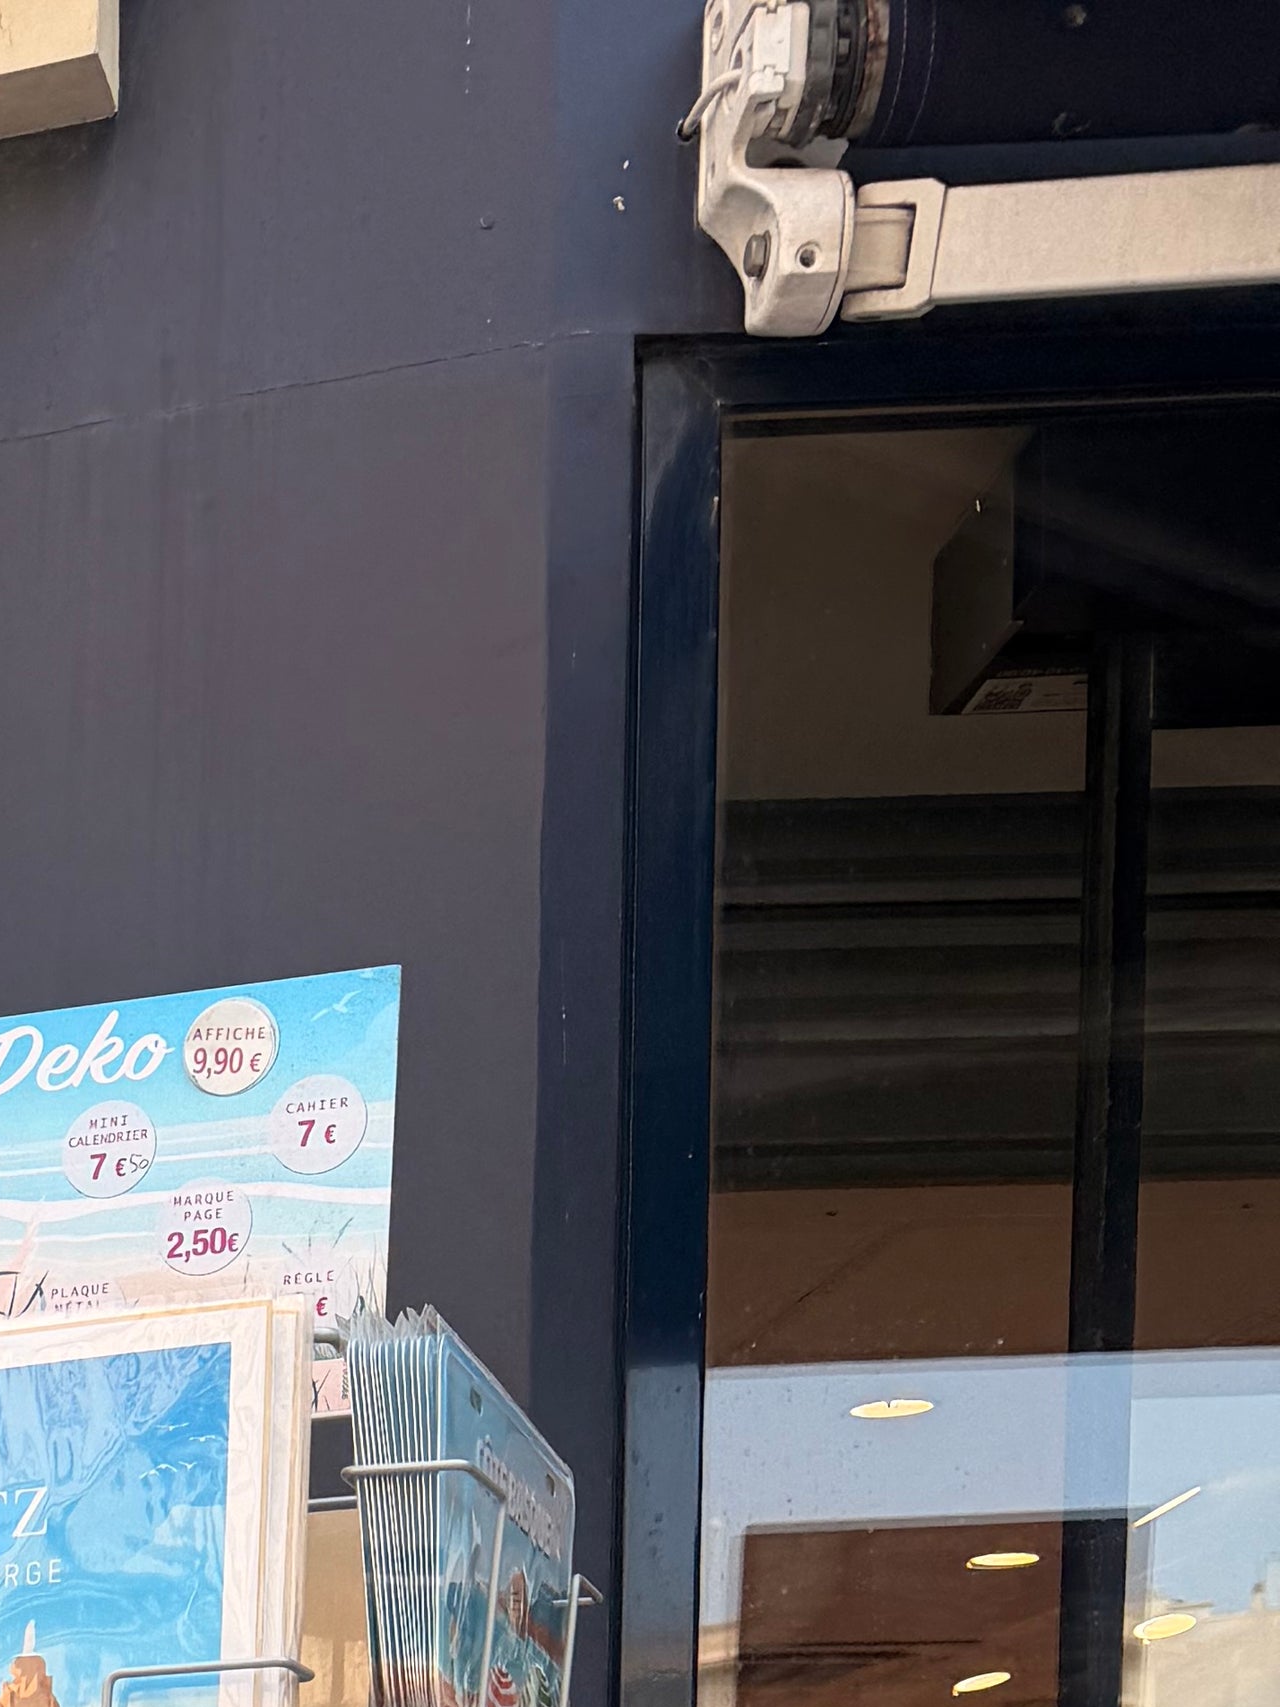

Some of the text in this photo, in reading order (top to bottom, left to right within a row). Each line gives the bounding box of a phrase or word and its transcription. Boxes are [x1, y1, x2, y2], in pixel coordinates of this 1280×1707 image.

[192, 1026, 266, 1041] AFFICHE
[192, 1047, 262, 1079] 9,90 €
[285, 1096, 349, 1114] CAHIER
[89, 1114, 129, 1129] MINI
[68, 1128, 148, 1148] CALENDRIER
[297, 1119, 337, 1147] 7 €
[90, 1152, 107, 1180] 7
[173, 1190, 235, 1206] MARQUE
[183, 1208, 224, 1222] PAGE
[50, 1282, 109, 1299] PLAQUE
